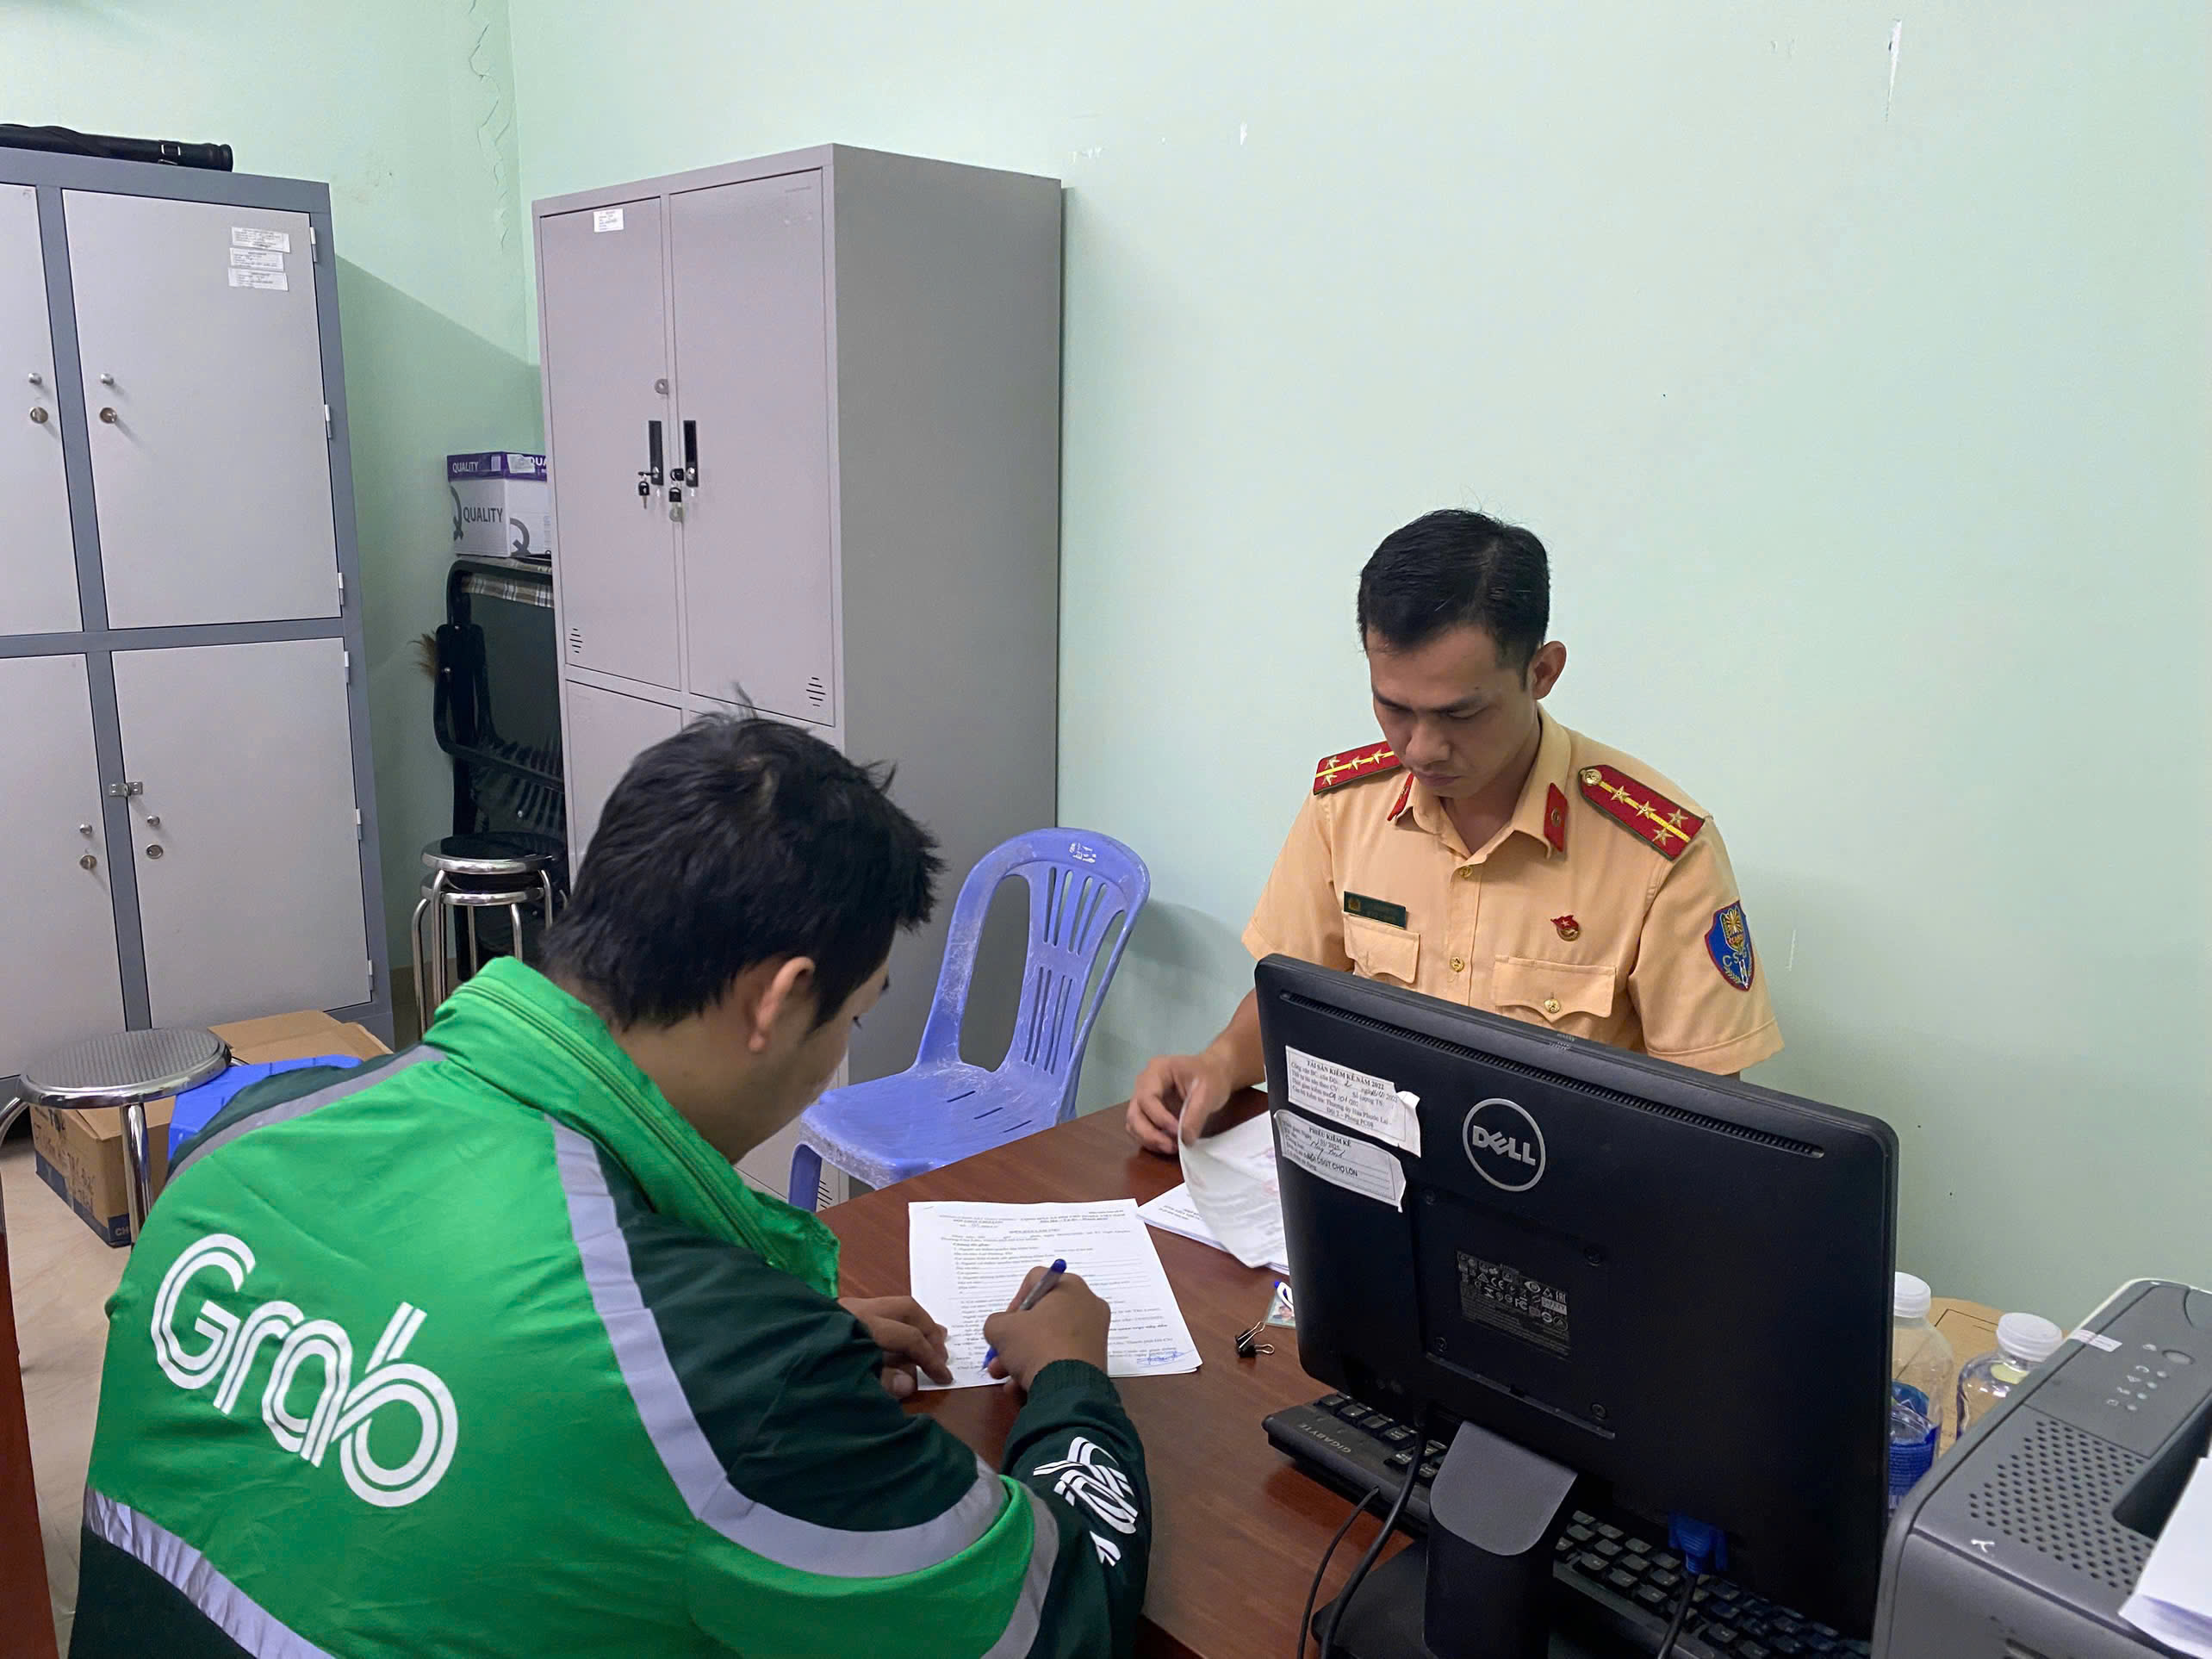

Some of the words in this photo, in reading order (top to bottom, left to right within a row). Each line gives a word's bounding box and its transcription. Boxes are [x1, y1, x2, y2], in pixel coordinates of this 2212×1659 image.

[452, 461, 479, 474] QUALITY
[463, 506, 503, 523] QUALITY
[1472, 1125, 1536, 1165] DELL
[151, 1233, 458, 1507] Grab
[1298, 1423, 1351, 1453] GIGABYTE
